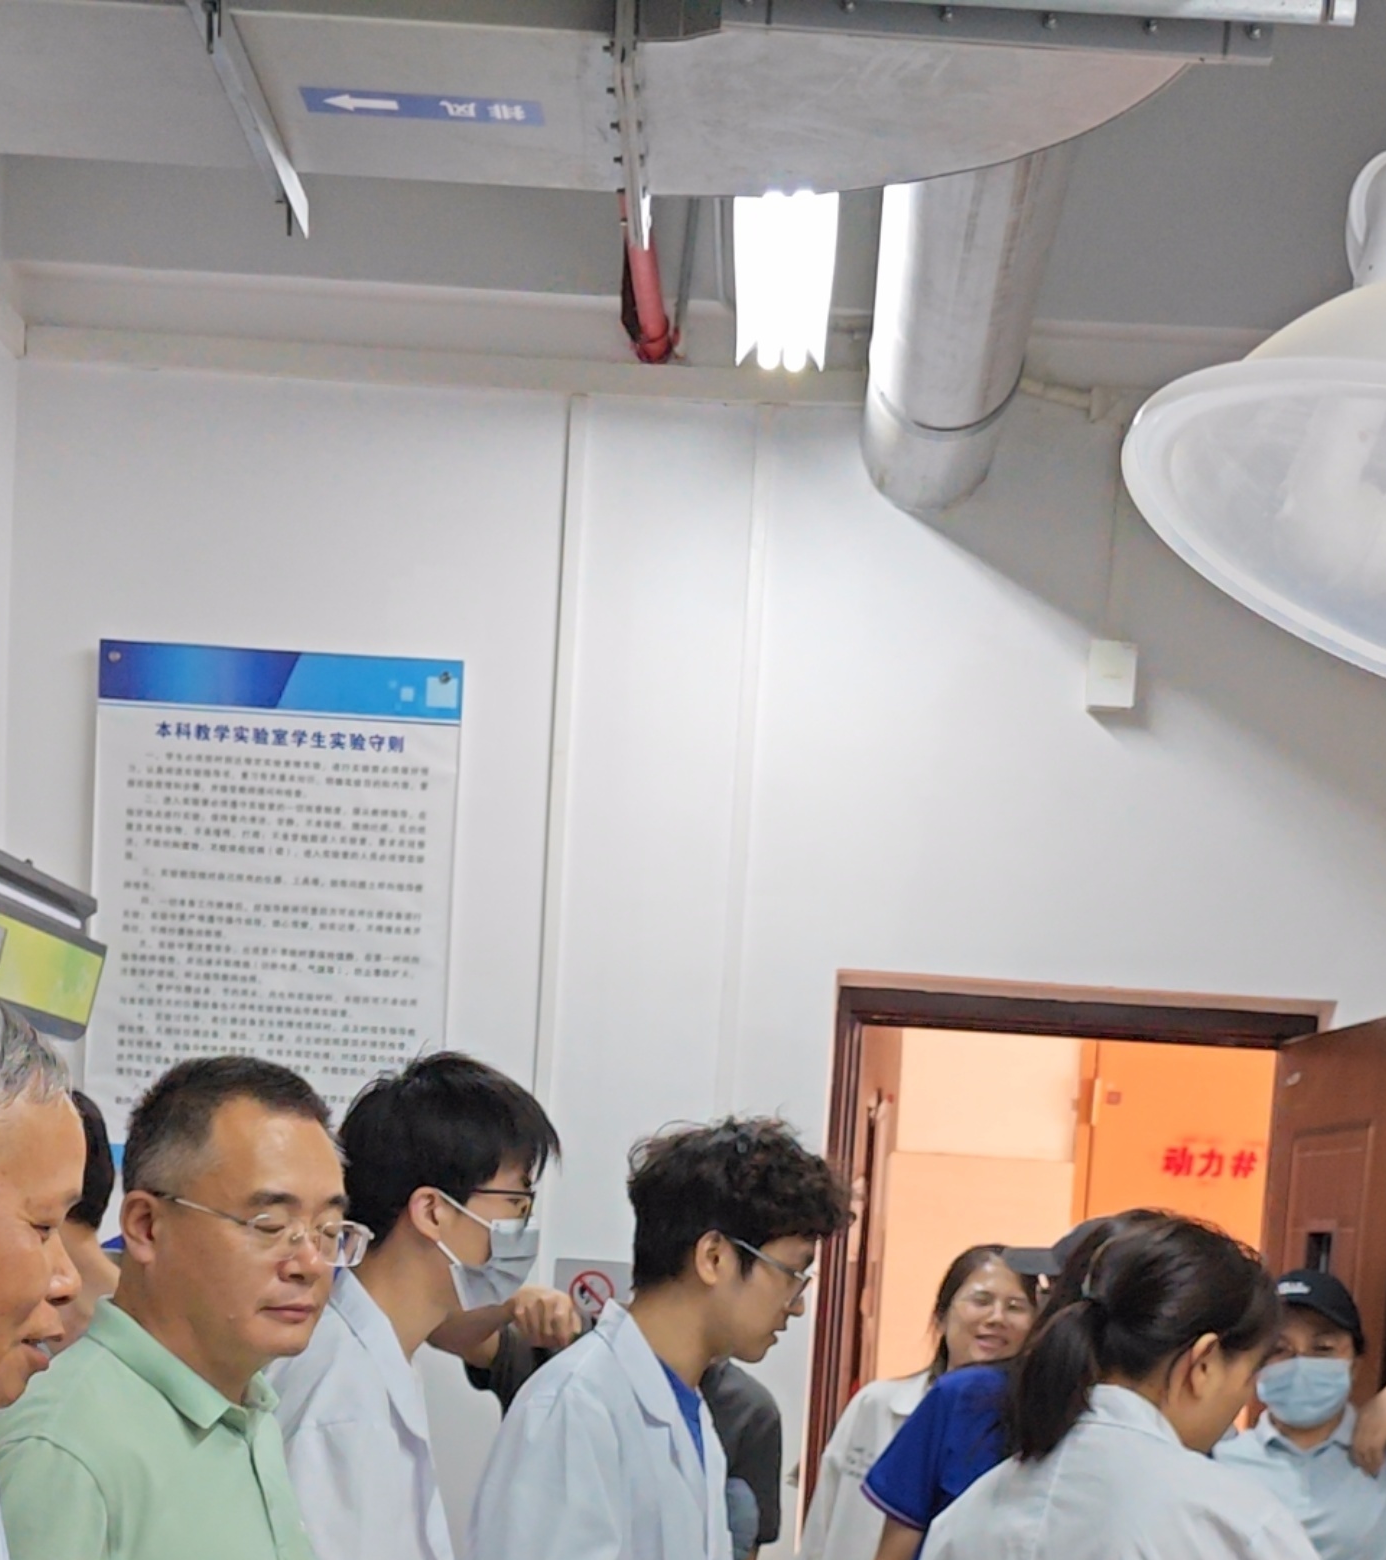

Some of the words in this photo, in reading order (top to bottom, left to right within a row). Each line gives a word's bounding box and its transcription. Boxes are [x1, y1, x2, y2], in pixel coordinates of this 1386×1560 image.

[154, 720, 406, 754] 本科教学实验室学生实验守则
